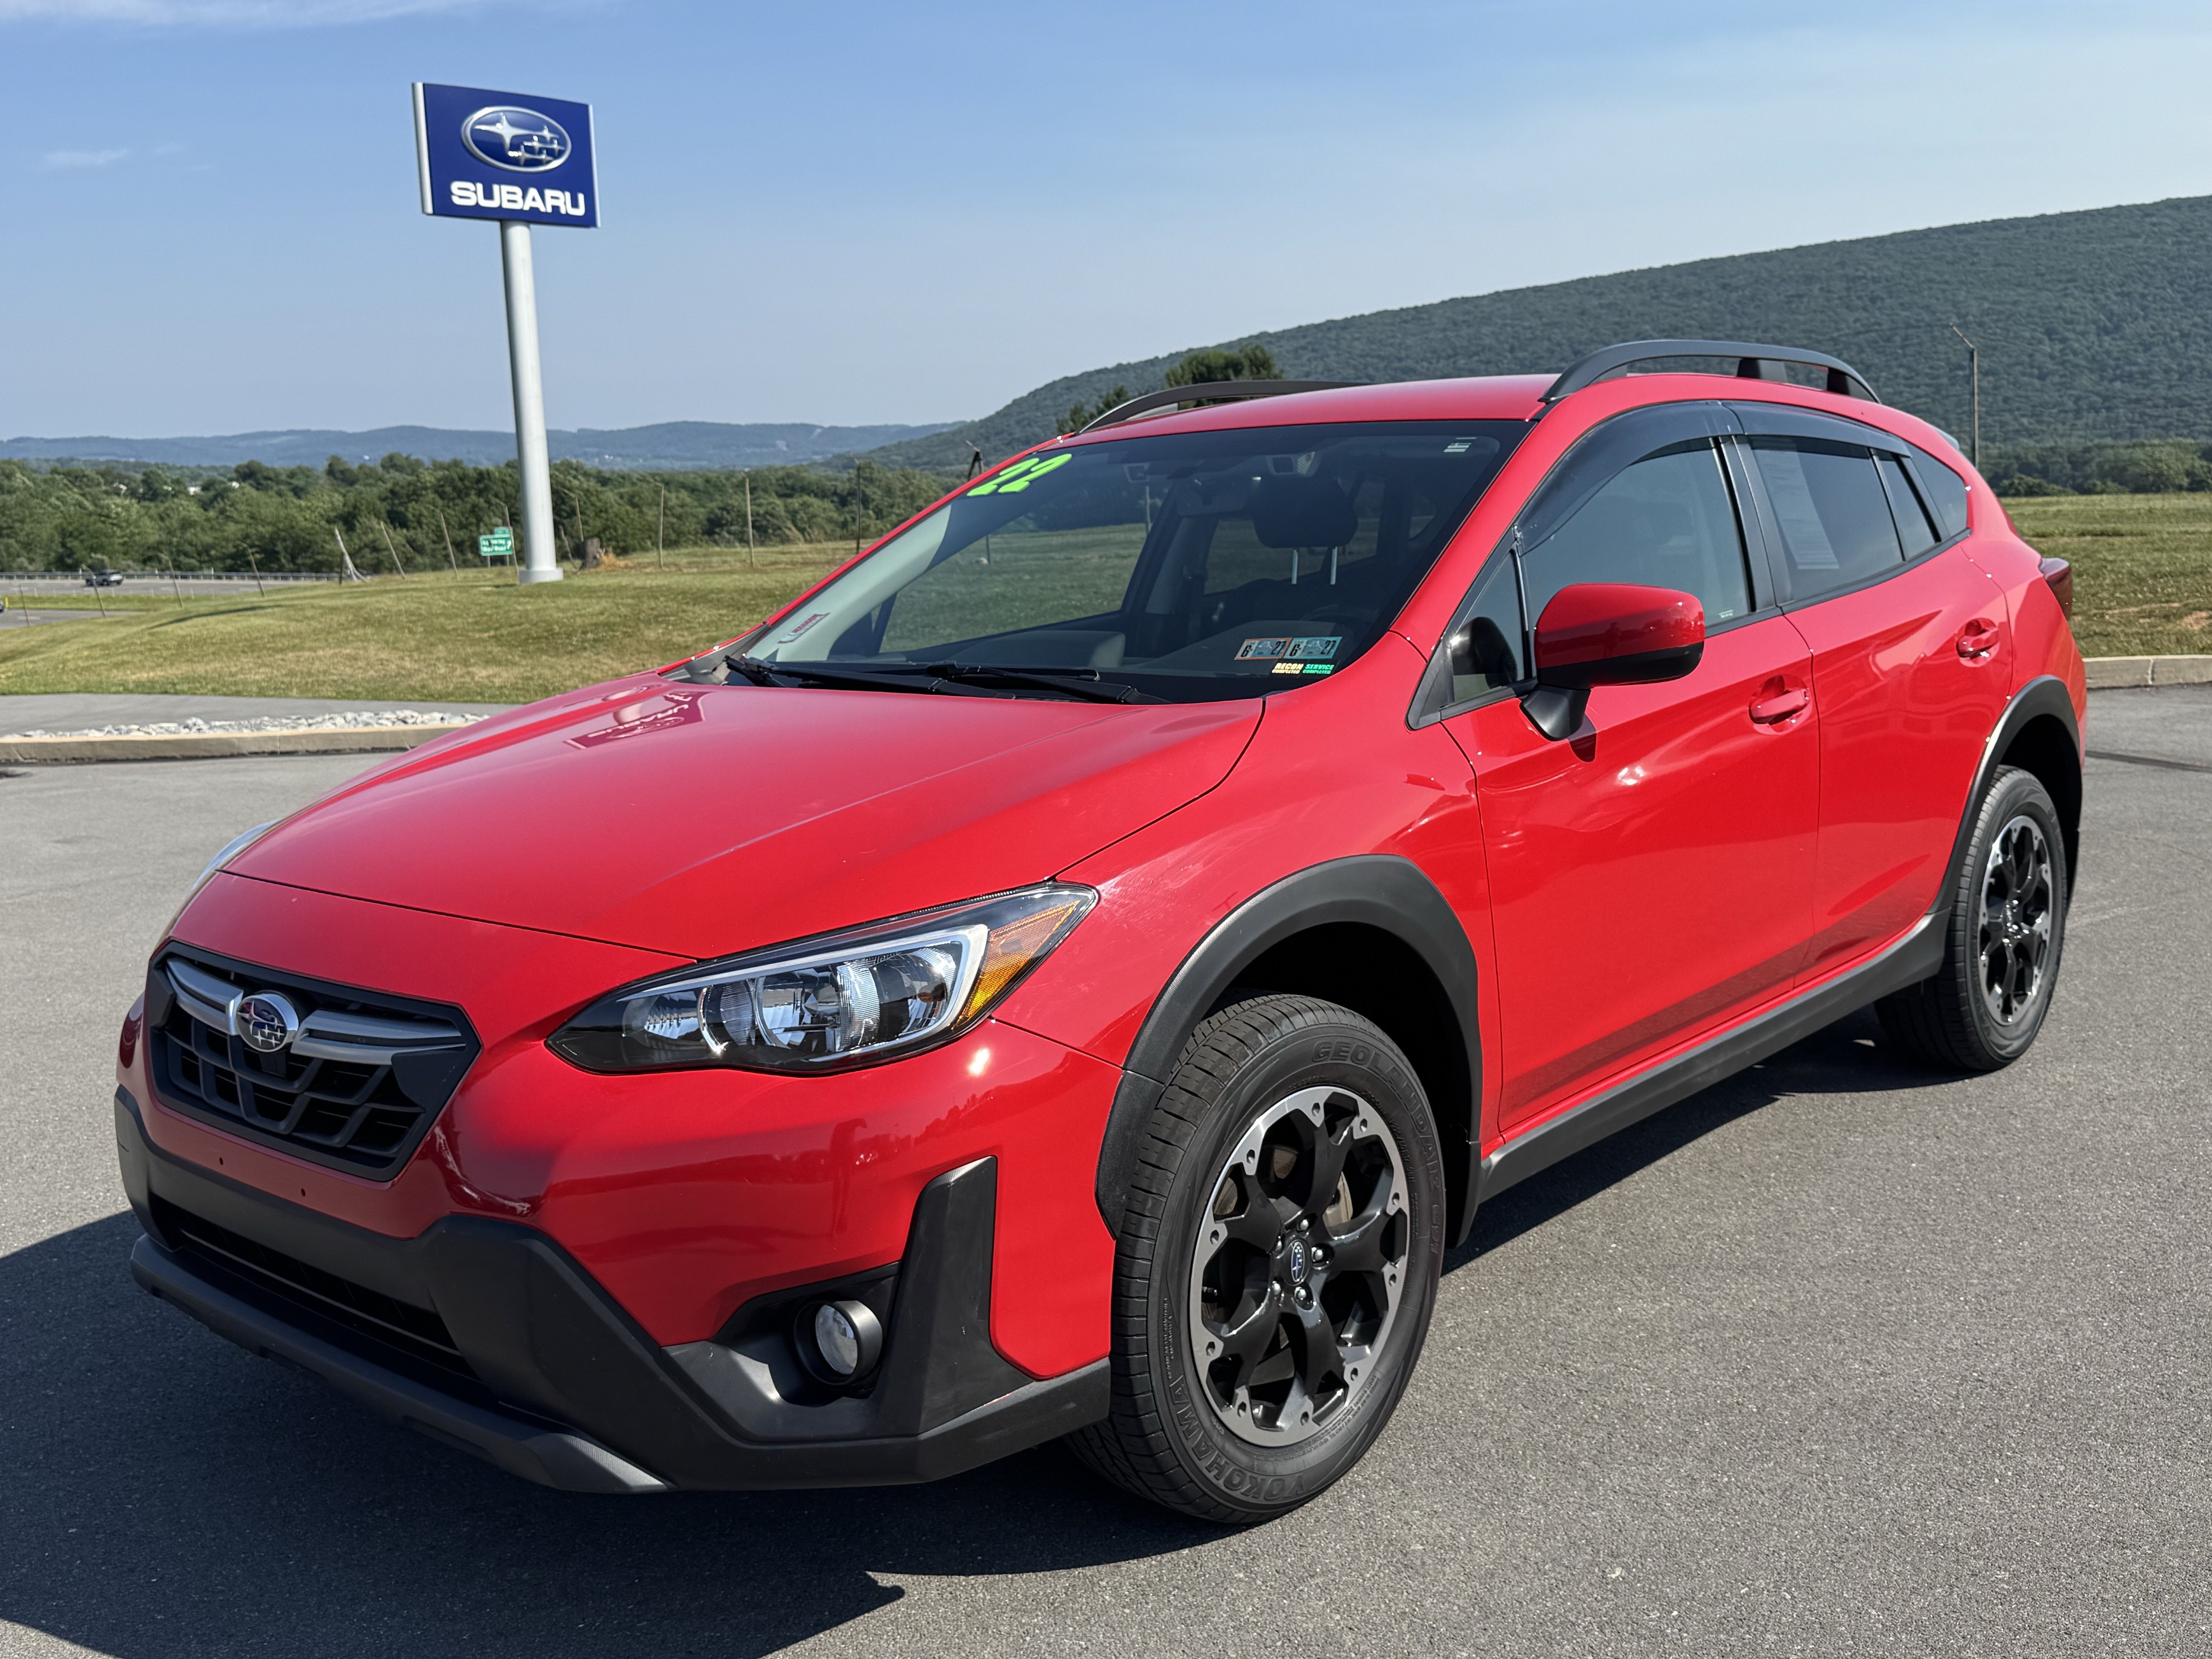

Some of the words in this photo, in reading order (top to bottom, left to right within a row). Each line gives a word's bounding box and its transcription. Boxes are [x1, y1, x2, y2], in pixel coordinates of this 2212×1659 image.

[450, 181, 585, 216] SUBARU
[967, 453, 1072, 496] 22
[1271, 641, 1287, 655] 27
[1321, 640, 1336, 654] 27
[1169, 1375, 1305, 1501] YOKOHAMA
